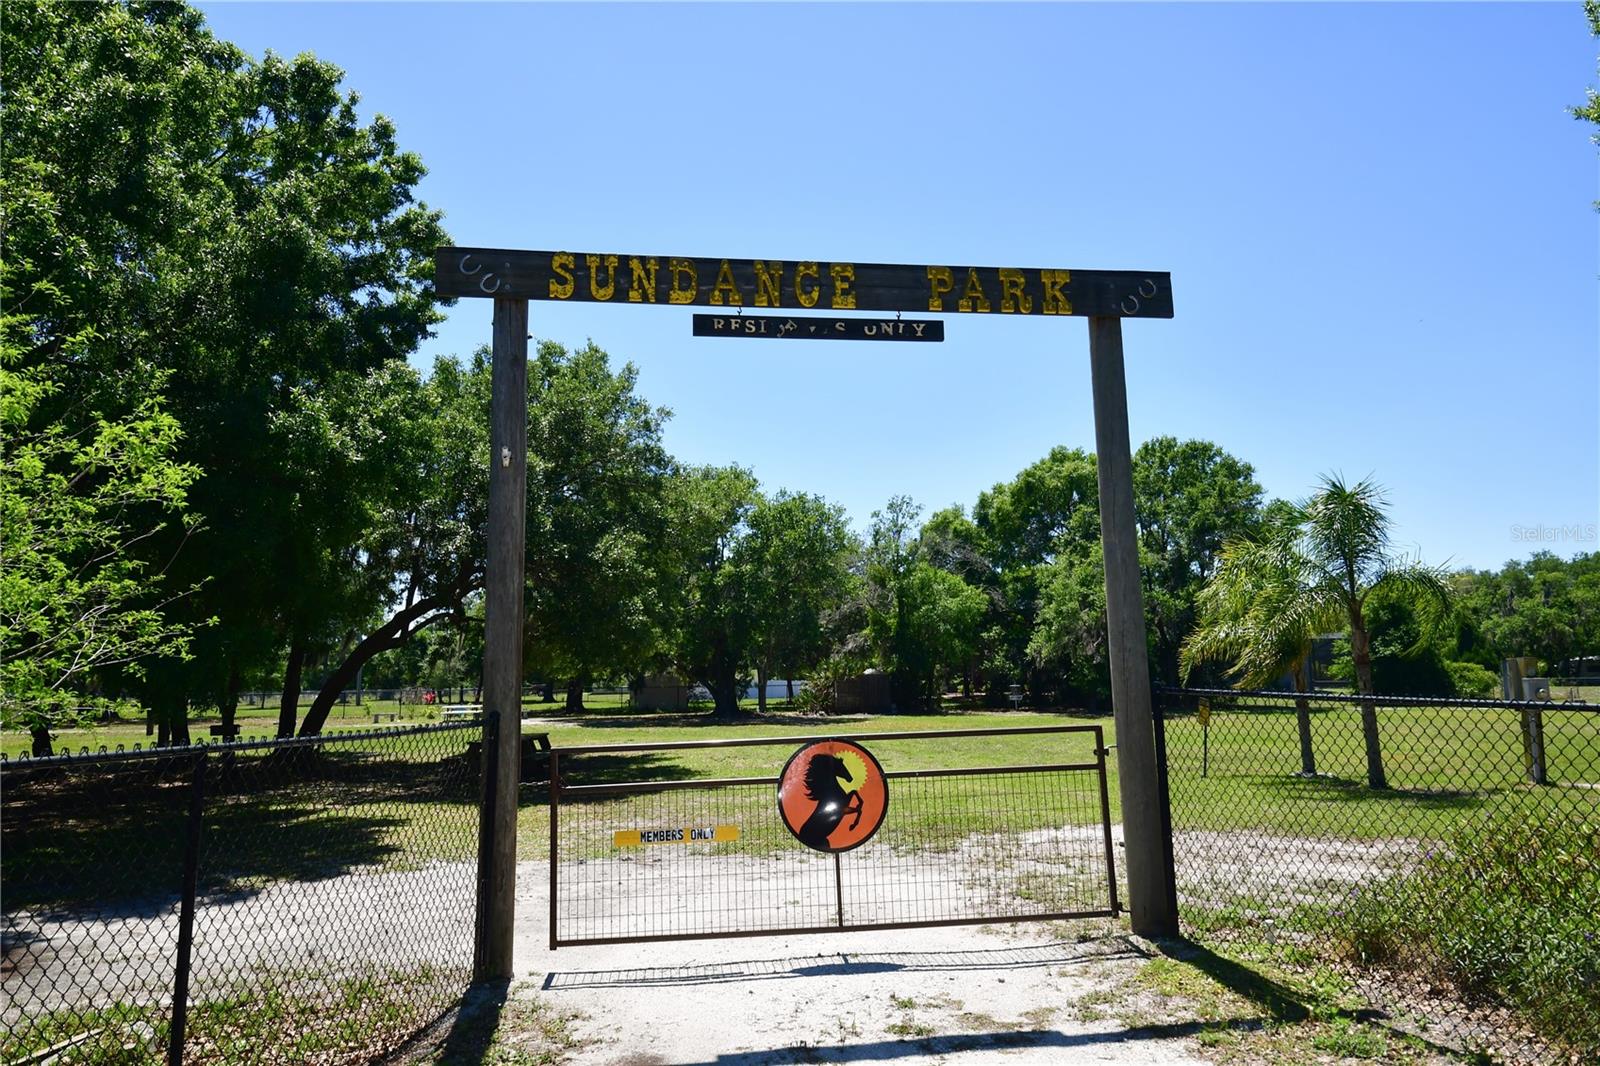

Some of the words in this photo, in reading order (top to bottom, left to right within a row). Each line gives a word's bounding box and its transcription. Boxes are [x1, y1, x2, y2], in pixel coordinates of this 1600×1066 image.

[549, 251, 857, 309] SUNDANCE
[927, 266, 1073, 315] PARK
[640, 829, 684, 843] MEMBERS
[690, 827, 715, 840] ONLY
